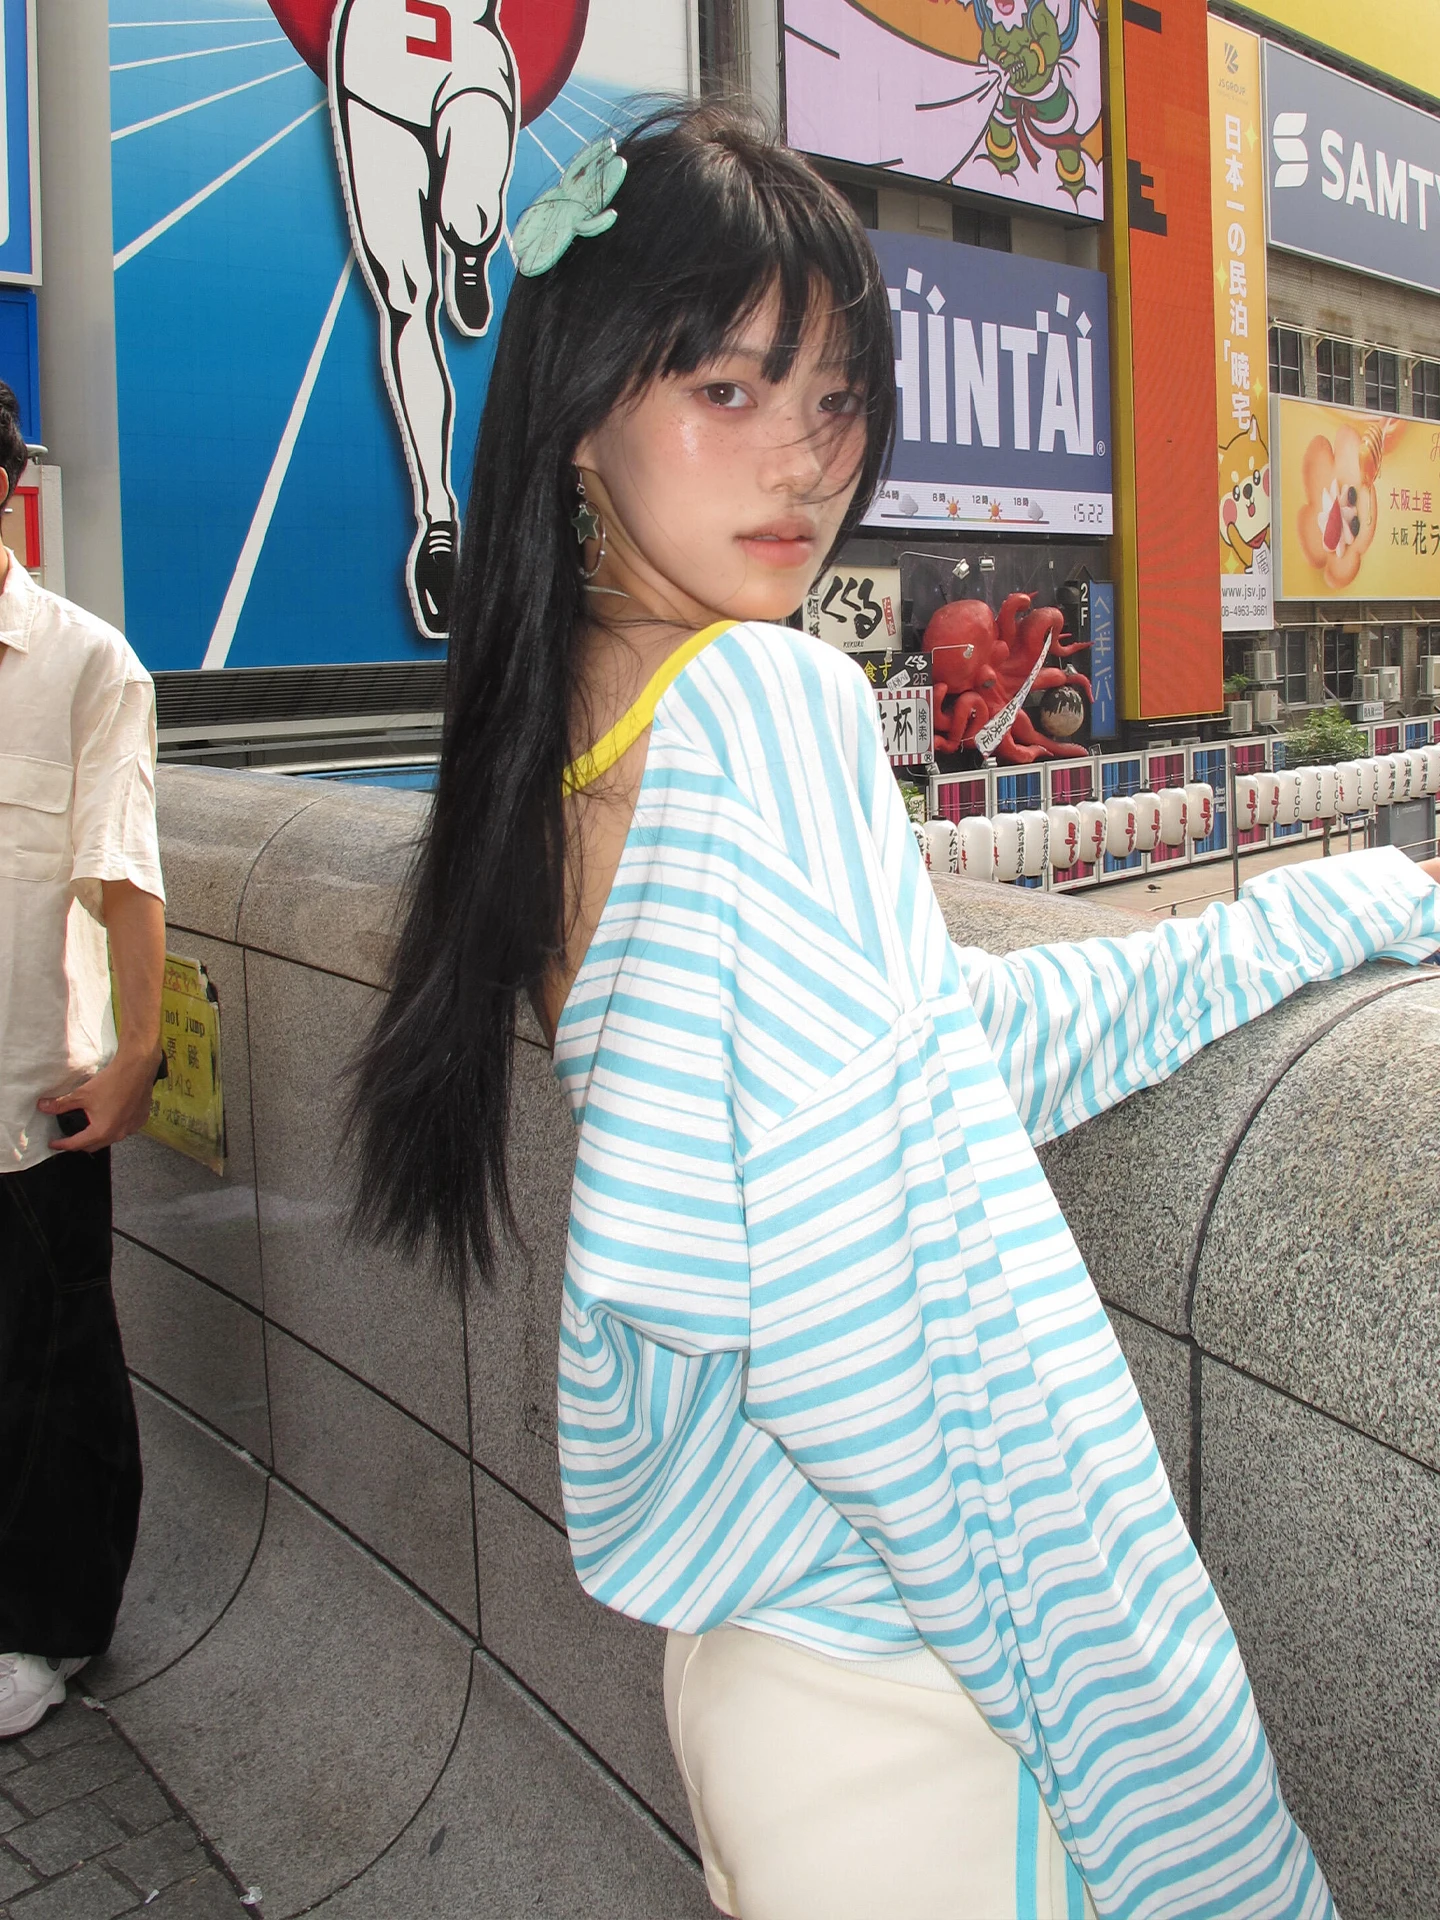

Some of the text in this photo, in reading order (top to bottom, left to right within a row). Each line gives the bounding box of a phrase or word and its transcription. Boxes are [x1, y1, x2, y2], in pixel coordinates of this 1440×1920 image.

[1320, 129, 1440, 231] SAMT
[888, 268, 1094, 457] HINTAI
[1390, 488, 1432, 512] 大阪土産
[1221, 584, 1267, 601] www.jsv.jp
[913, 672, 928, 686] 2F
[165, 1010, 205, 1038] not jump
